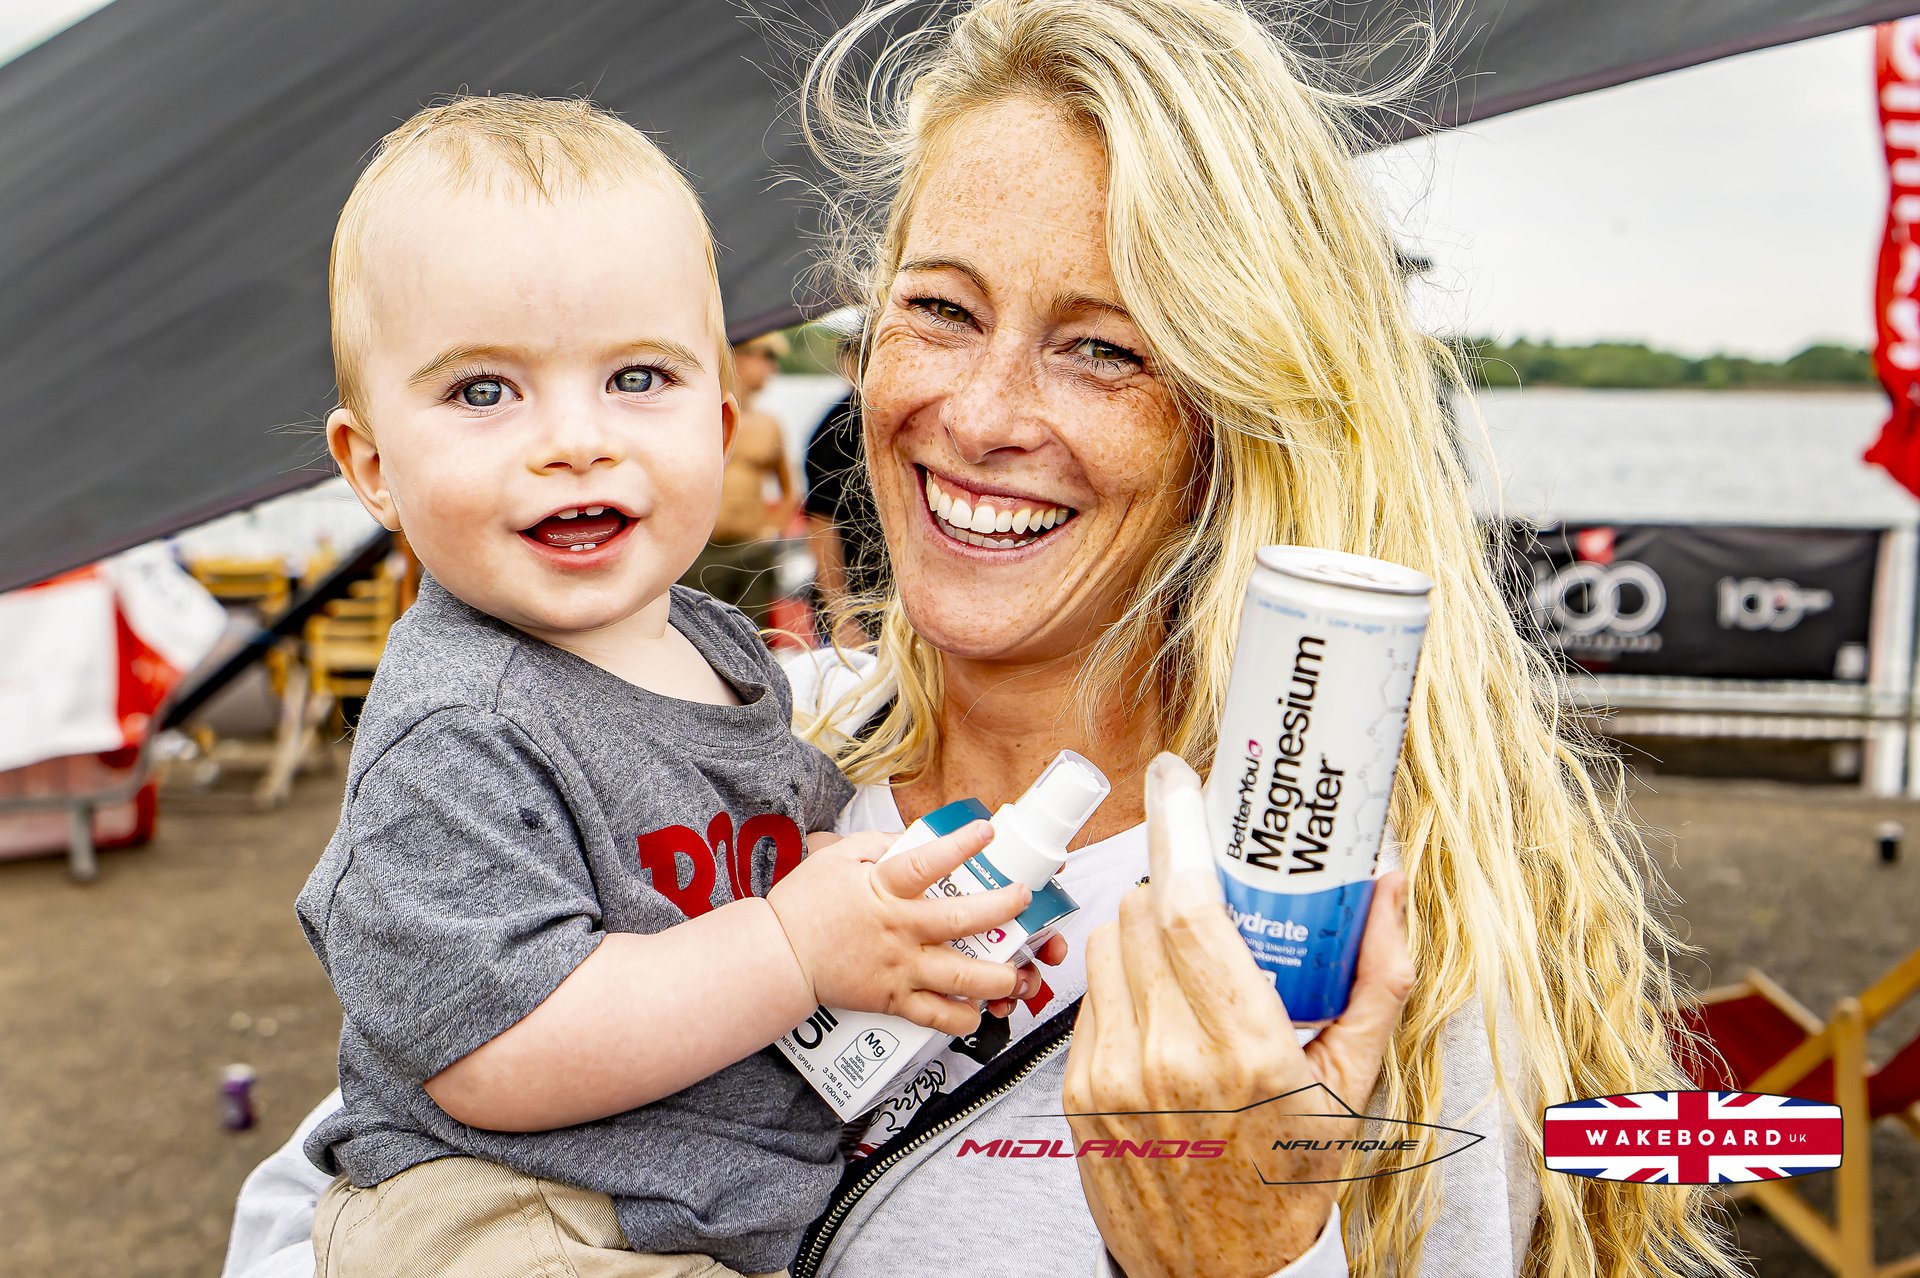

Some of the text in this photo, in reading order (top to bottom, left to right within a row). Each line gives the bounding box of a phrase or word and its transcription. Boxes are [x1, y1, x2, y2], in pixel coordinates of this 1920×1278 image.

[1246, 634, 1328, 872] Magnesium
[1226, 757, 1260, 860] BetterYou
[1229, 904, 1309, 943] ydrate
[864, 1032, 886, 1058] Mg
[797, 1053, 815, 1073] SPRAY
[841, 1056, 864, 1082] magnesium
[822, 1082, 846, 1108] (100ml)
[843, 1090, 852, 1100] oz
